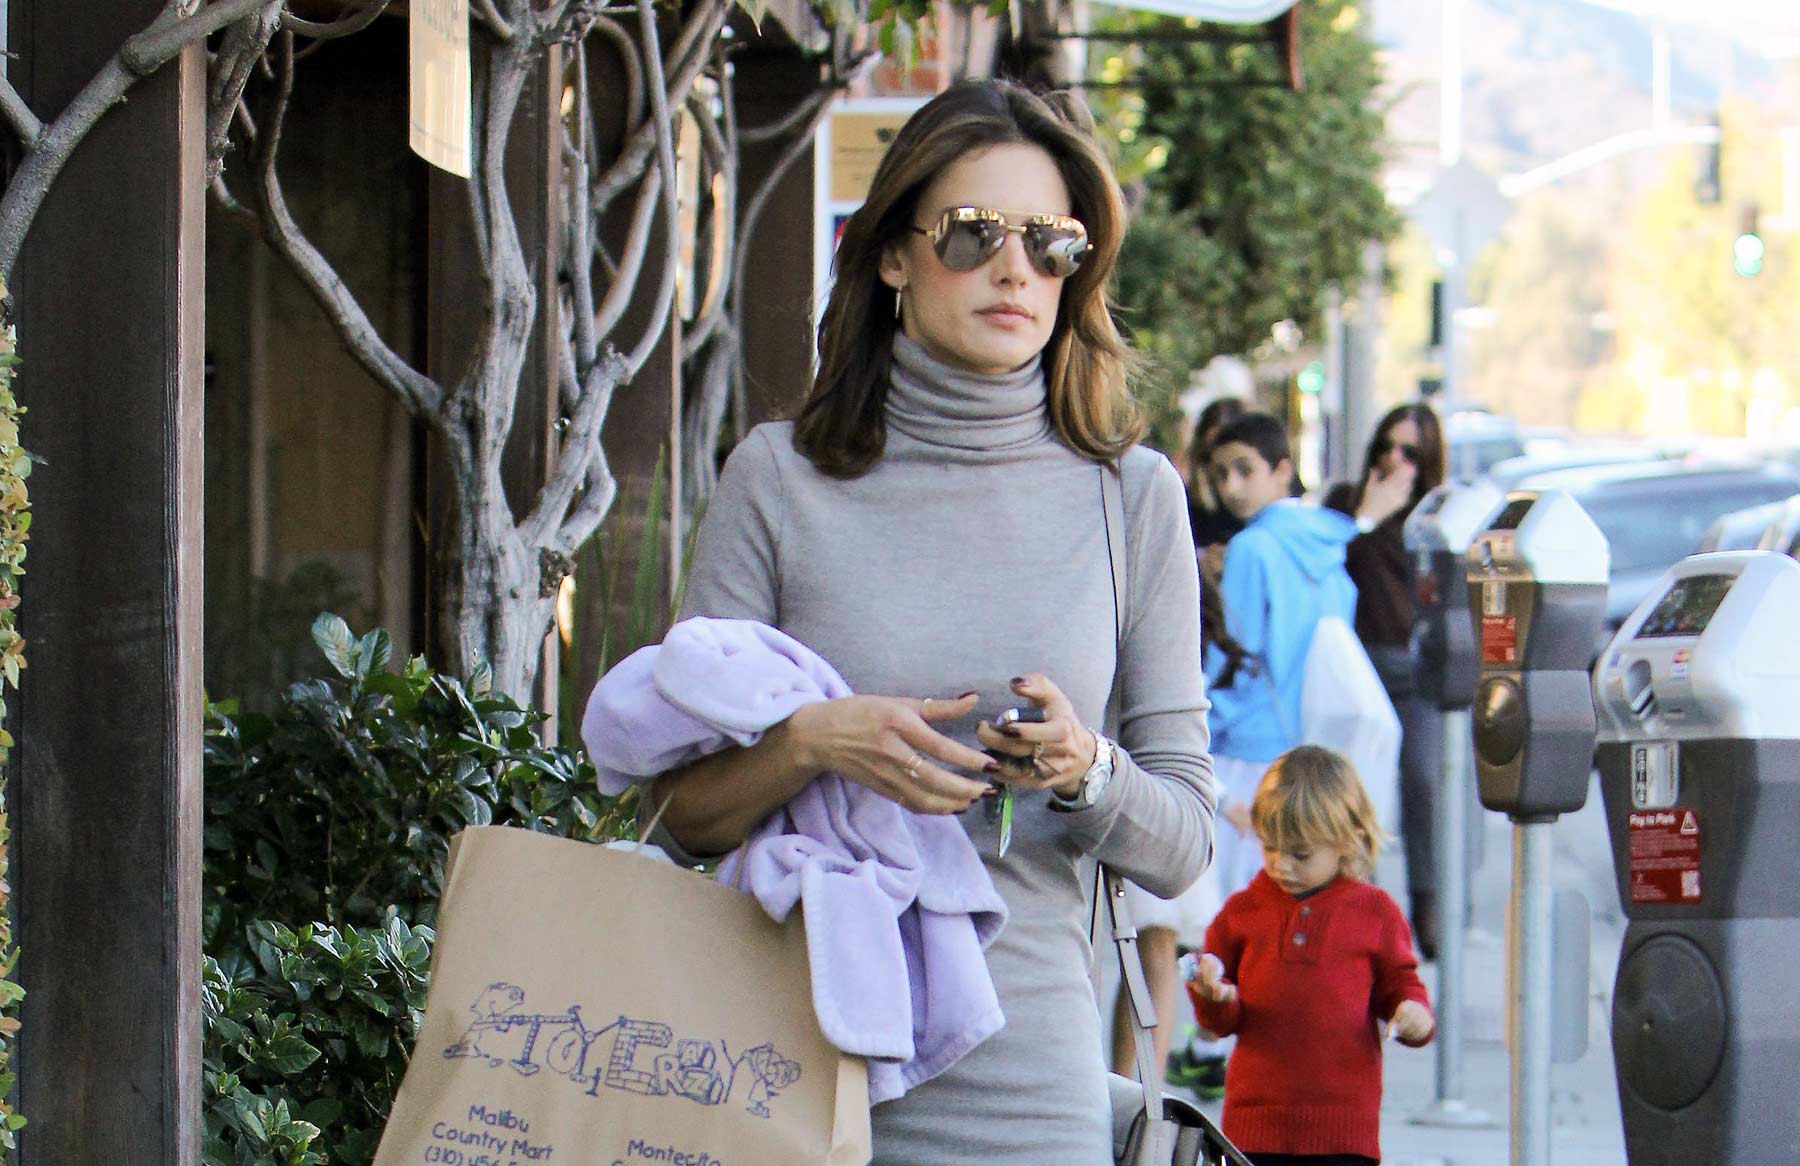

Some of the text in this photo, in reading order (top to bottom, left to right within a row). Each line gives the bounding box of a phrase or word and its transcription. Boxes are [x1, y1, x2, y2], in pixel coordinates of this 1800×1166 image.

[468, 1104, 529, 1134] Malibu
[432, 1121, 553, 1161] Country Mart
